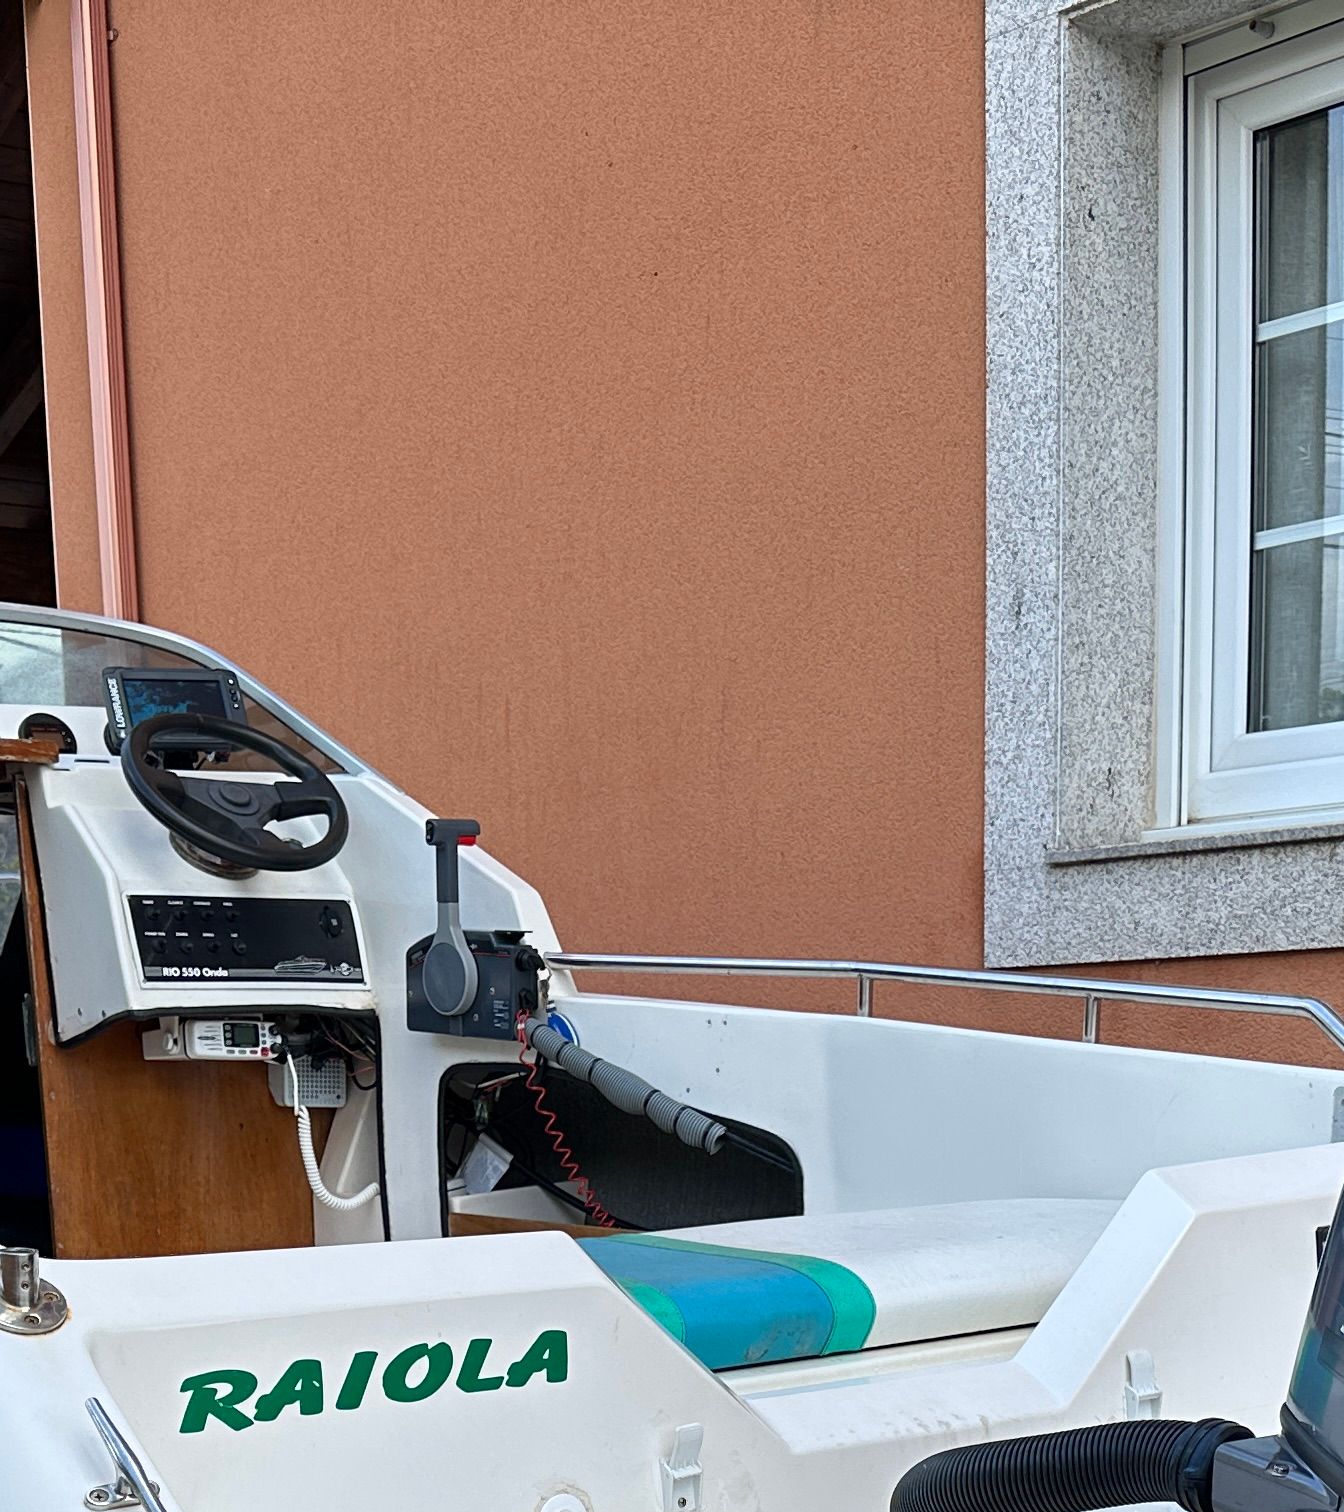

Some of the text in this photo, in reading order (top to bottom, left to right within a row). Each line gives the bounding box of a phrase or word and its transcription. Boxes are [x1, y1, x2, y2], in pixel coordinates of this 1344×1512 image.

[162, 966, 229, 977] RIO 550 Onda
[179, 1329, 568, 1434] RAIOLA
